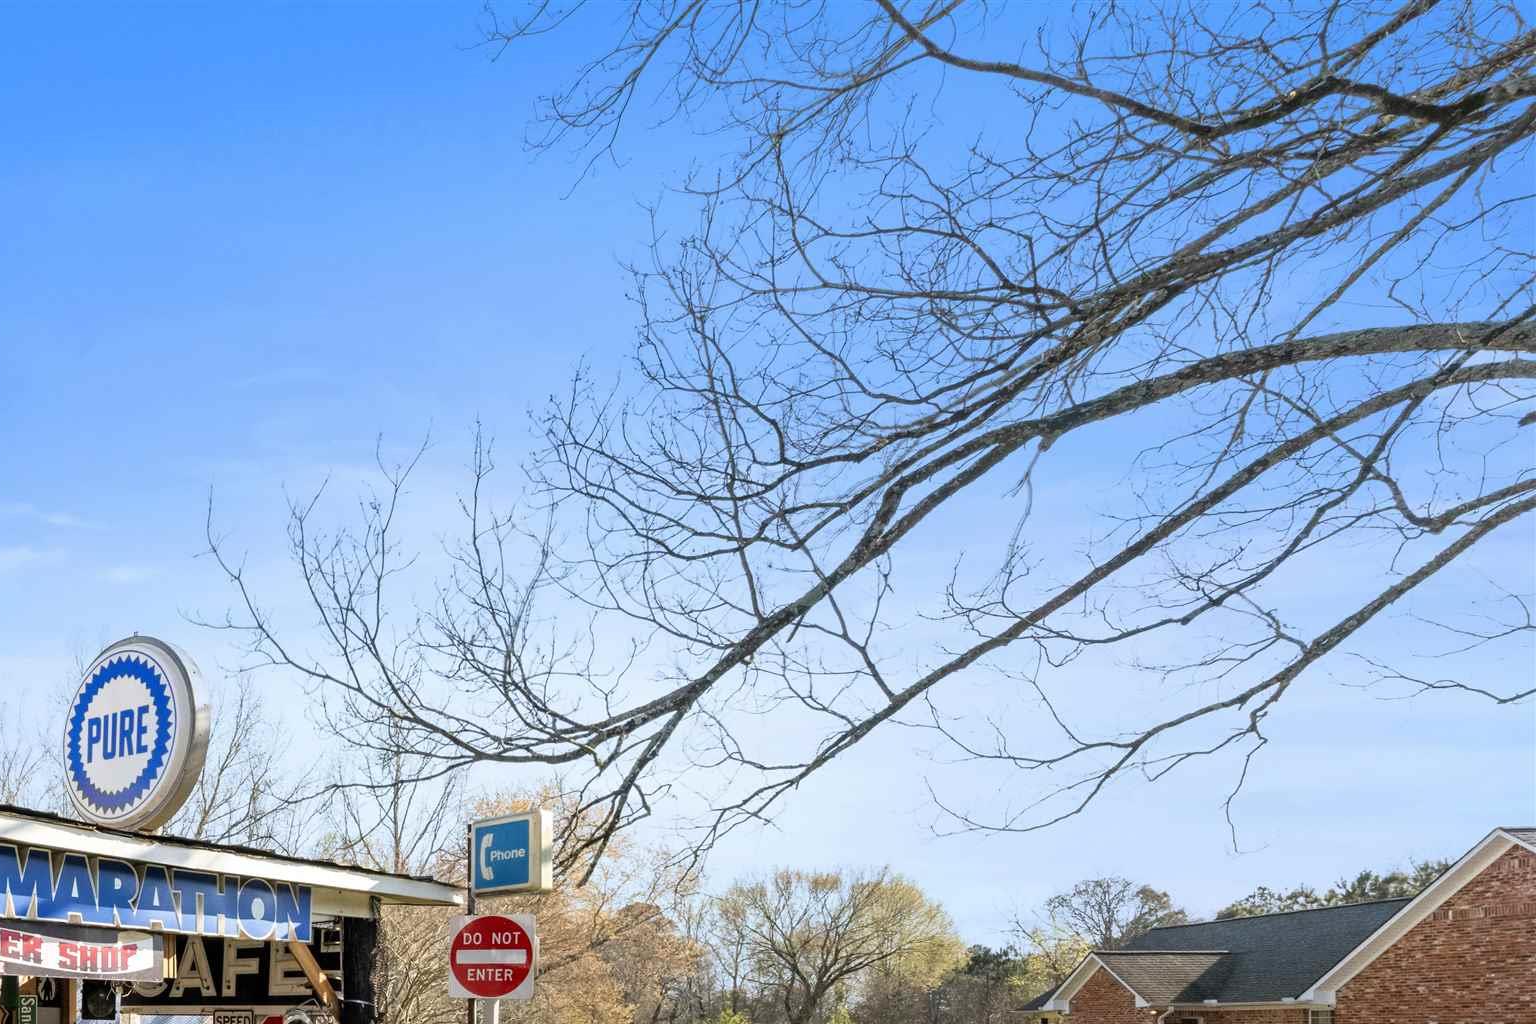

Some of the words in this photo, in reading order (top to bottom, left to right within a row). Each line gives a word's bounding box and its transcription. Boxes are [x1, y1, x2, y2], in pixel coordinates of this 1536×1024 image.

[87, 703, 150, 763] PURE
[490, 846, 526, 862] Phone
[463, 931, 482, 945] DO
[491, 931, 521, 945] NOT
[58, 941, 138, 973] SHOP
[134, 935, 315, 998] AFE
[467, 967, 513, 982] ENTER
